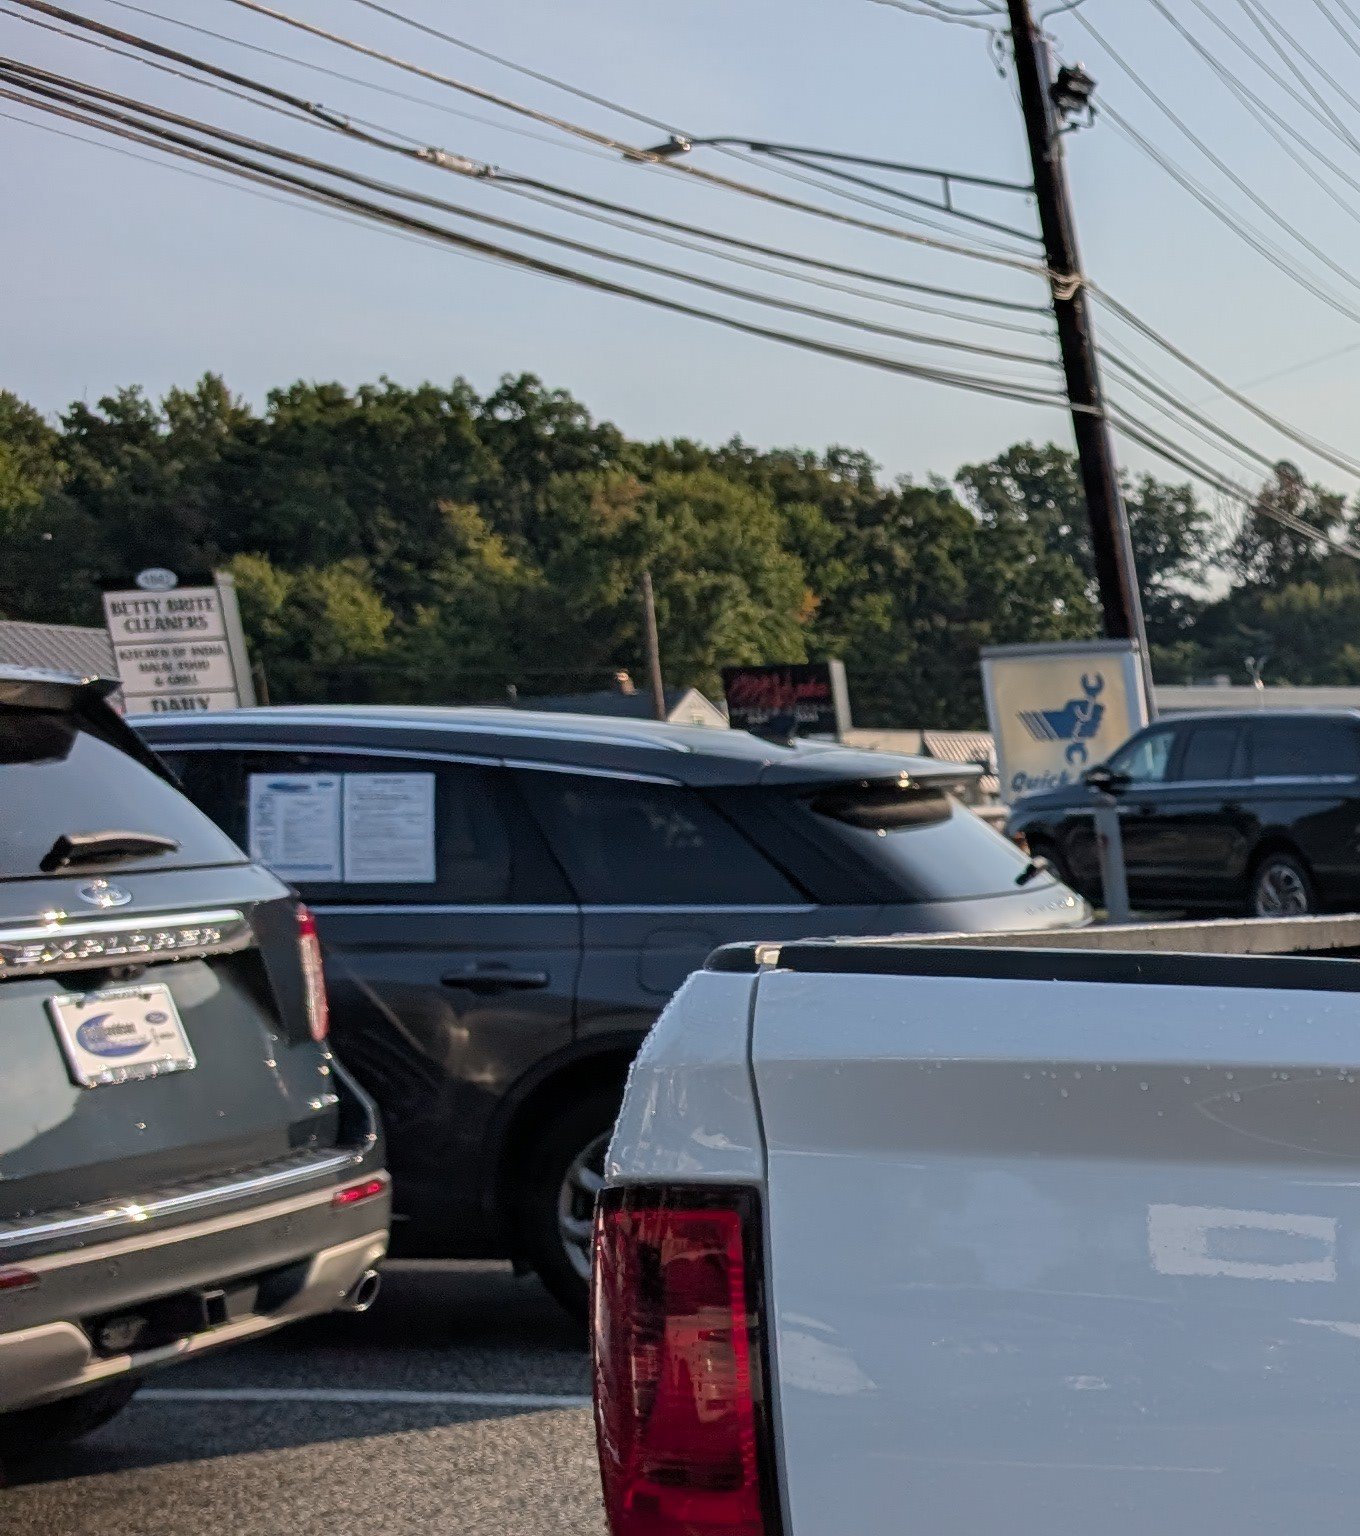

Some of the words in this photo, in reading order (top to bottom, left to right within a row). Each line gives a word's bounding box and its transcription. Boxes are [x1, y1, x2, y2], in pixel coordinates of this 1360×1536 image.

[110, 599, 161, 617] BETTY
[166, 597, 216, 613] BRITE
[123, 615, 209, 633] CLEANERS
